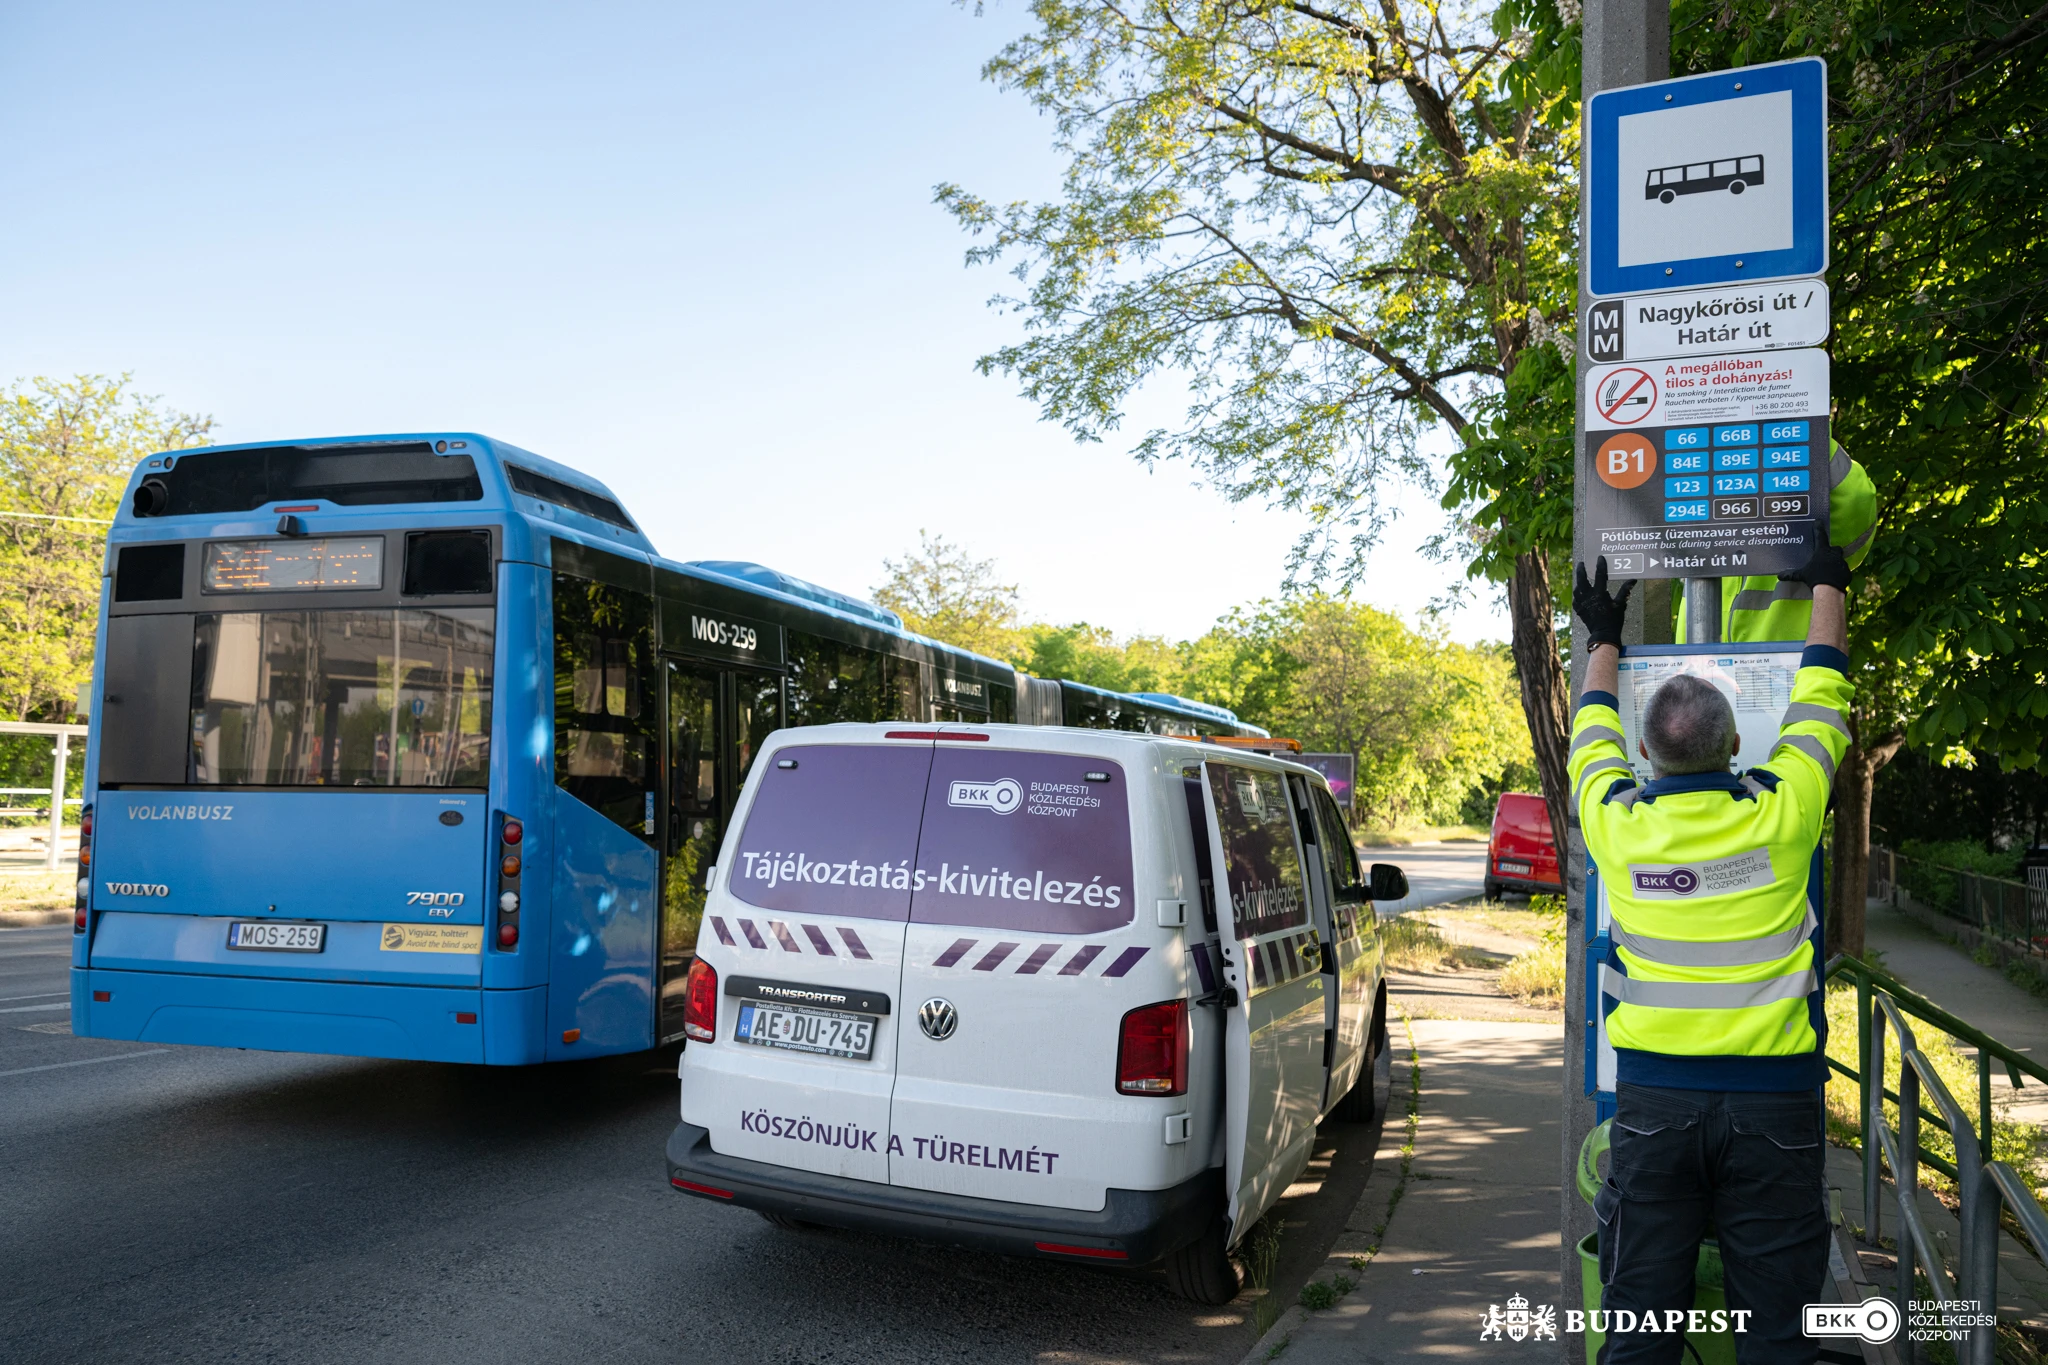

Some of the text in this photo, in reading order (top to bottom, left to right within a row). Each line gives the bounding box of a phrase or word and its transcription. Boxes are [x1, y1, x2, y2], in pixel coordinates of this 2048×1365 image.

[1639, 291, 1814, 325] Nagykőrösi út /
[1594, 309, 1618, 331] M
[1678, 321, 1772, 345] Határ út
[1594, 333, 1618, 354] M
[1665, 359, 1763, 375] A megállóban
[1665, 369, 1793, 388] tilos a dohányzás!
[1713, 386, 1756, 395] Interdiction
[1768, 384, 1791, 392] fumer
[1697, 397, 1729, 405] verboten
[1677, 426, 1801, 445] 66 66B 66E
[1608, 448, 1644, 474] B1
[1672, 450, 1801, 469] 84E 89E 94E
[1674, 475, 1800, 493] 123 123A 148
[1668, 500, 1802, 517] 294E 966 999
[1601, 524, 1789, 542] Pótlóbusz (üzemzavar esetén)
[1601, 535, 1804, 552] Replacement bus (during service disruptions)
[1614, 554, 1747, 569] 52 Határ út M
[691, 615, 757, 651] MOS-259
[958, 788, 990, 800] BKK
[1030, 782, 1089, 795] BUDAPESTI
[1029, 793, 1101, 808] KÖZLEKEDÉSI
[1027, 804, 1078, 818] KÖZPONT
[1703, 856, 1755, 874] BUDAPESTI
[1704, 862, 1768, 882] KÖZLEKEDÉSI
[742, 851, 1122, 909] Tájékoztatás-kivitelezés
[1641, 876, 1669, 887] BKK
[1706, 875, 1752, 891] KÖZPONT
[105, 882, 169, 897] VOLVO
[406, 891, 464, 906] 7900
[429, 908, 455, 918] EEV
[241, 926, 319, 946] MOS-259
[758, 985, 847, 1004] TRANSPORTER
[741, 1024, 749, 1034] H
[753, 1011, 783, 1039] AE
[741, 1108, 1059, 1175] KÖSZÖNJÜK A TÜRELMÉT
